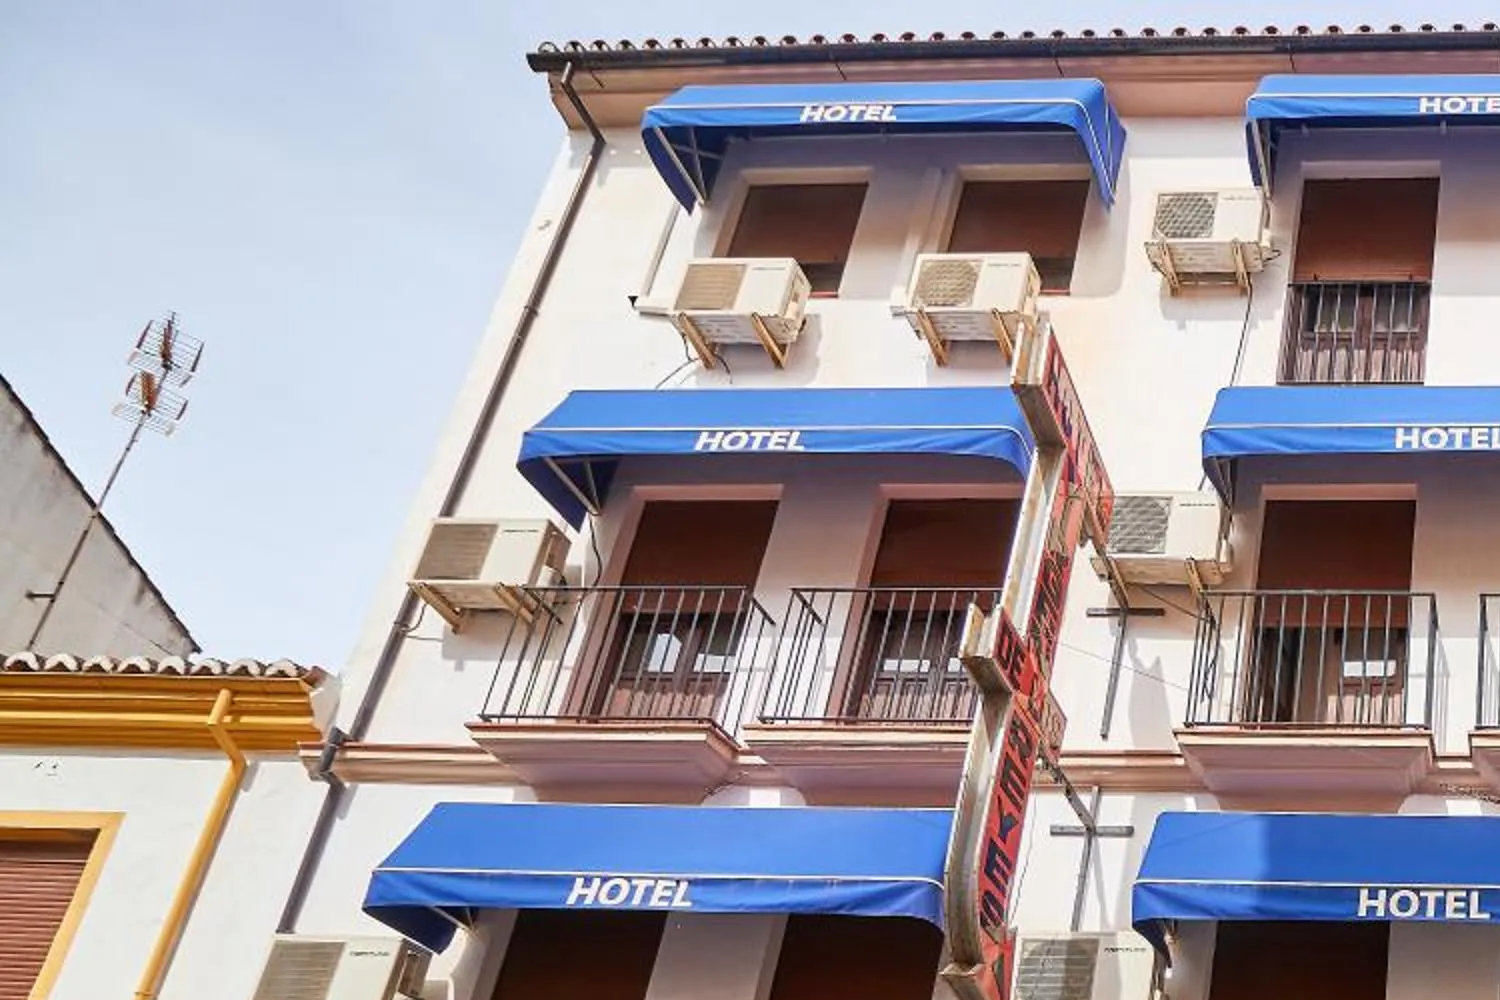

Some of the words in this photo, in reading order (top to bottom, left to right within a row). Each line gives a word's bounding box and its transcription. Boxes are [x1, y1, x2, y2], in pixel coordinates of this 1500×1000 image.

[800, 104, 897, 122] HOTEL
[694, 431, 805, 451] HOTEL
[565, 877, 694, 907] HOTEL
[1357, 888, 1491, 919] HOTEL
